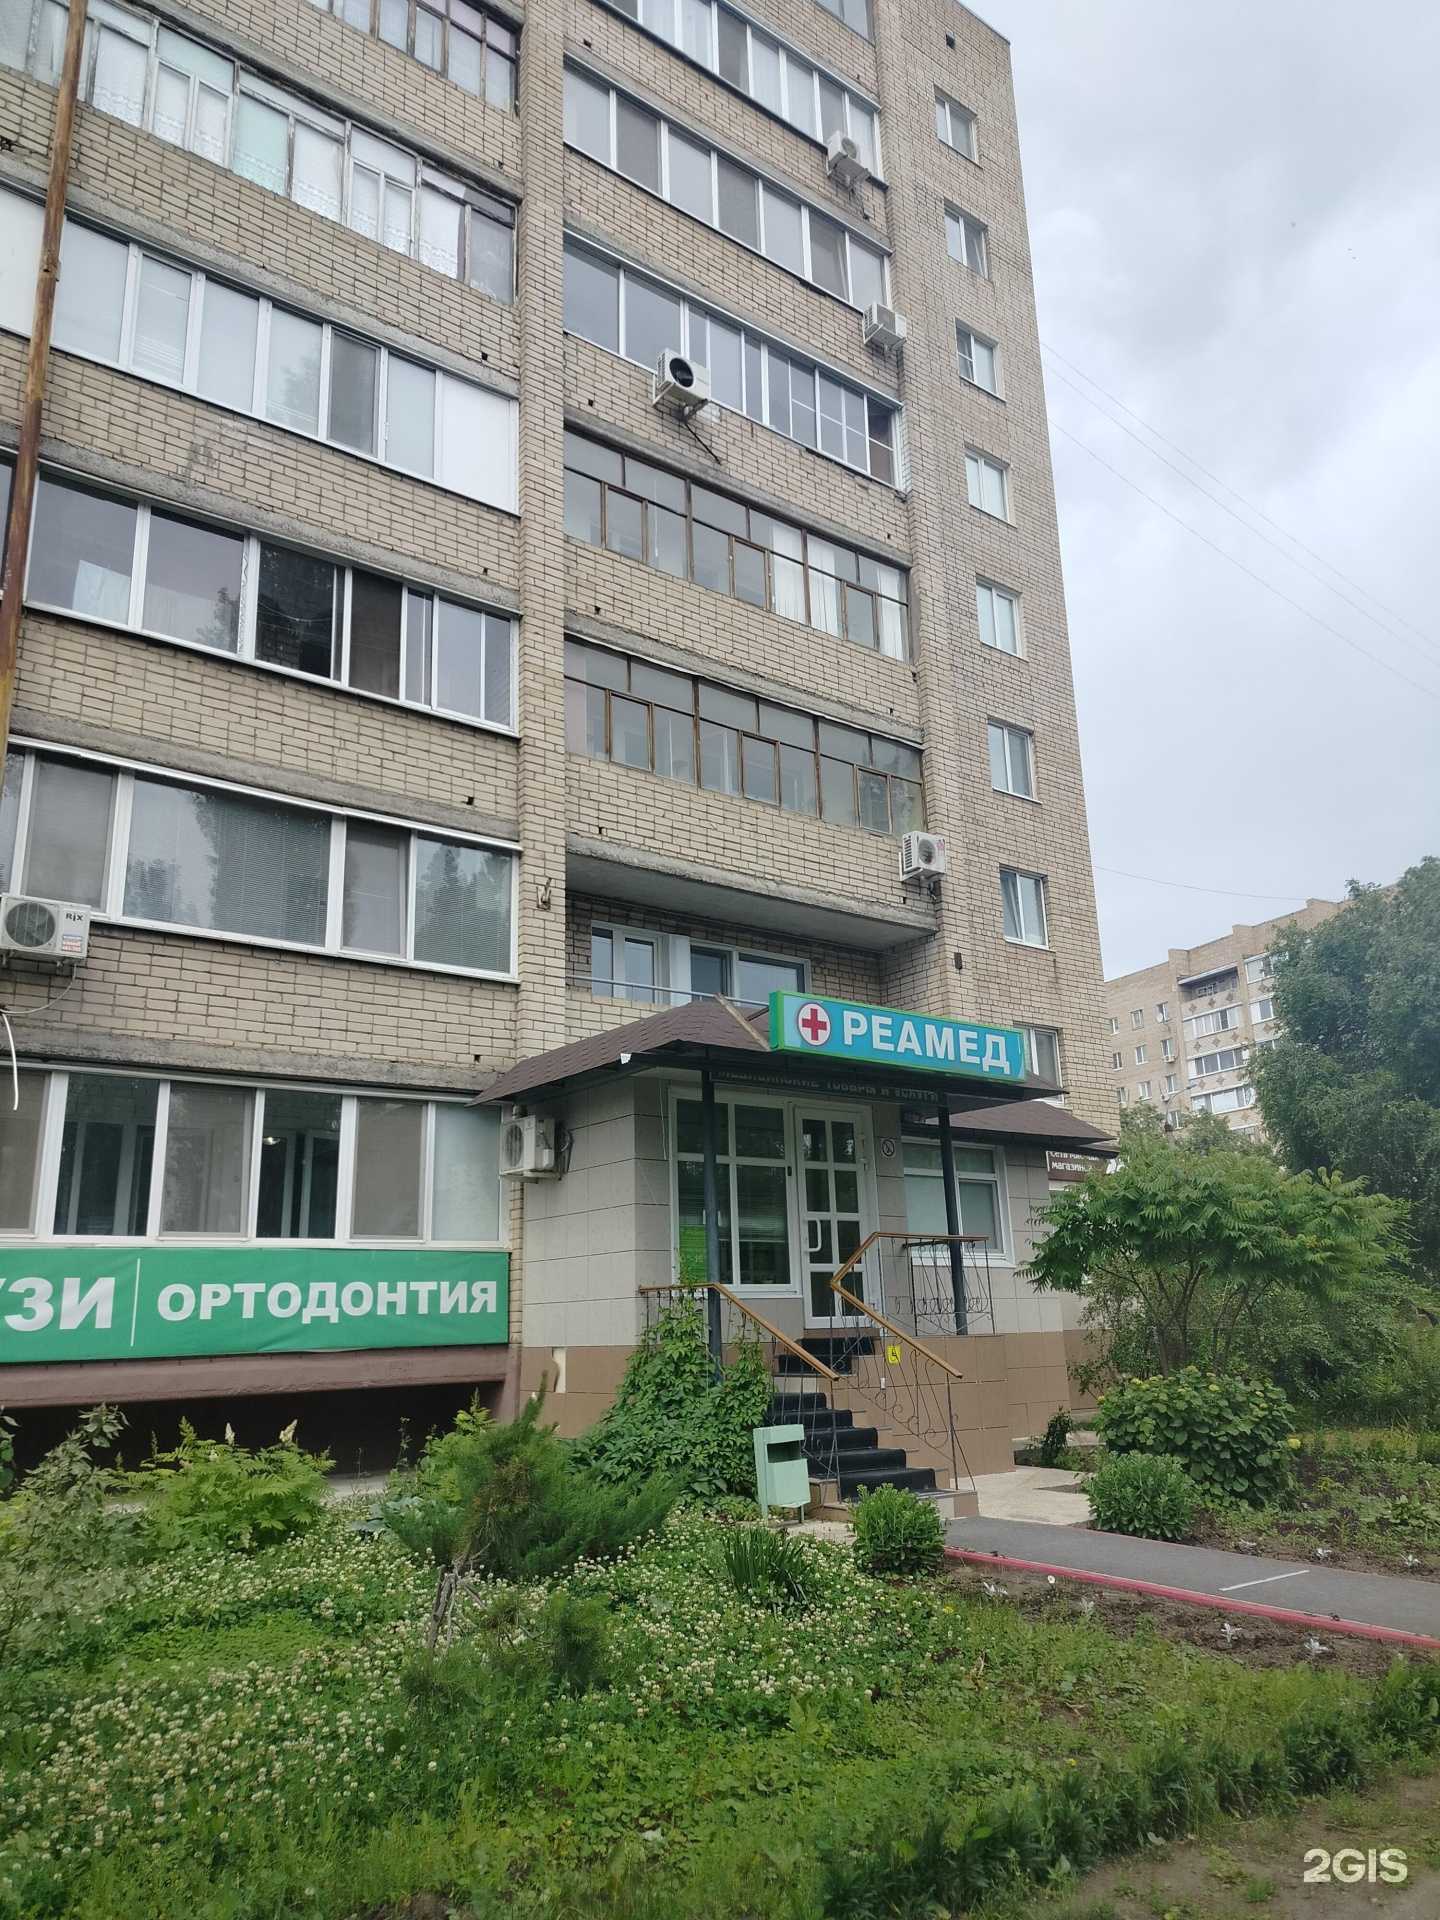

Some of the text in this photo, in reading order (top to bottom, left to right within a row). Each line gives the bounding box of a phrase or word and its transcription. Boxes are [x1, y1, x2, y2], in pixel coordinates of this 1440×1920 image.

[842, 1010, 1011, 1075] РЕАМЕД
[0, 1277, 116, 1332] ЗИ
[157, 1280, 498, 1324] ОРТОДОНТИЯ
